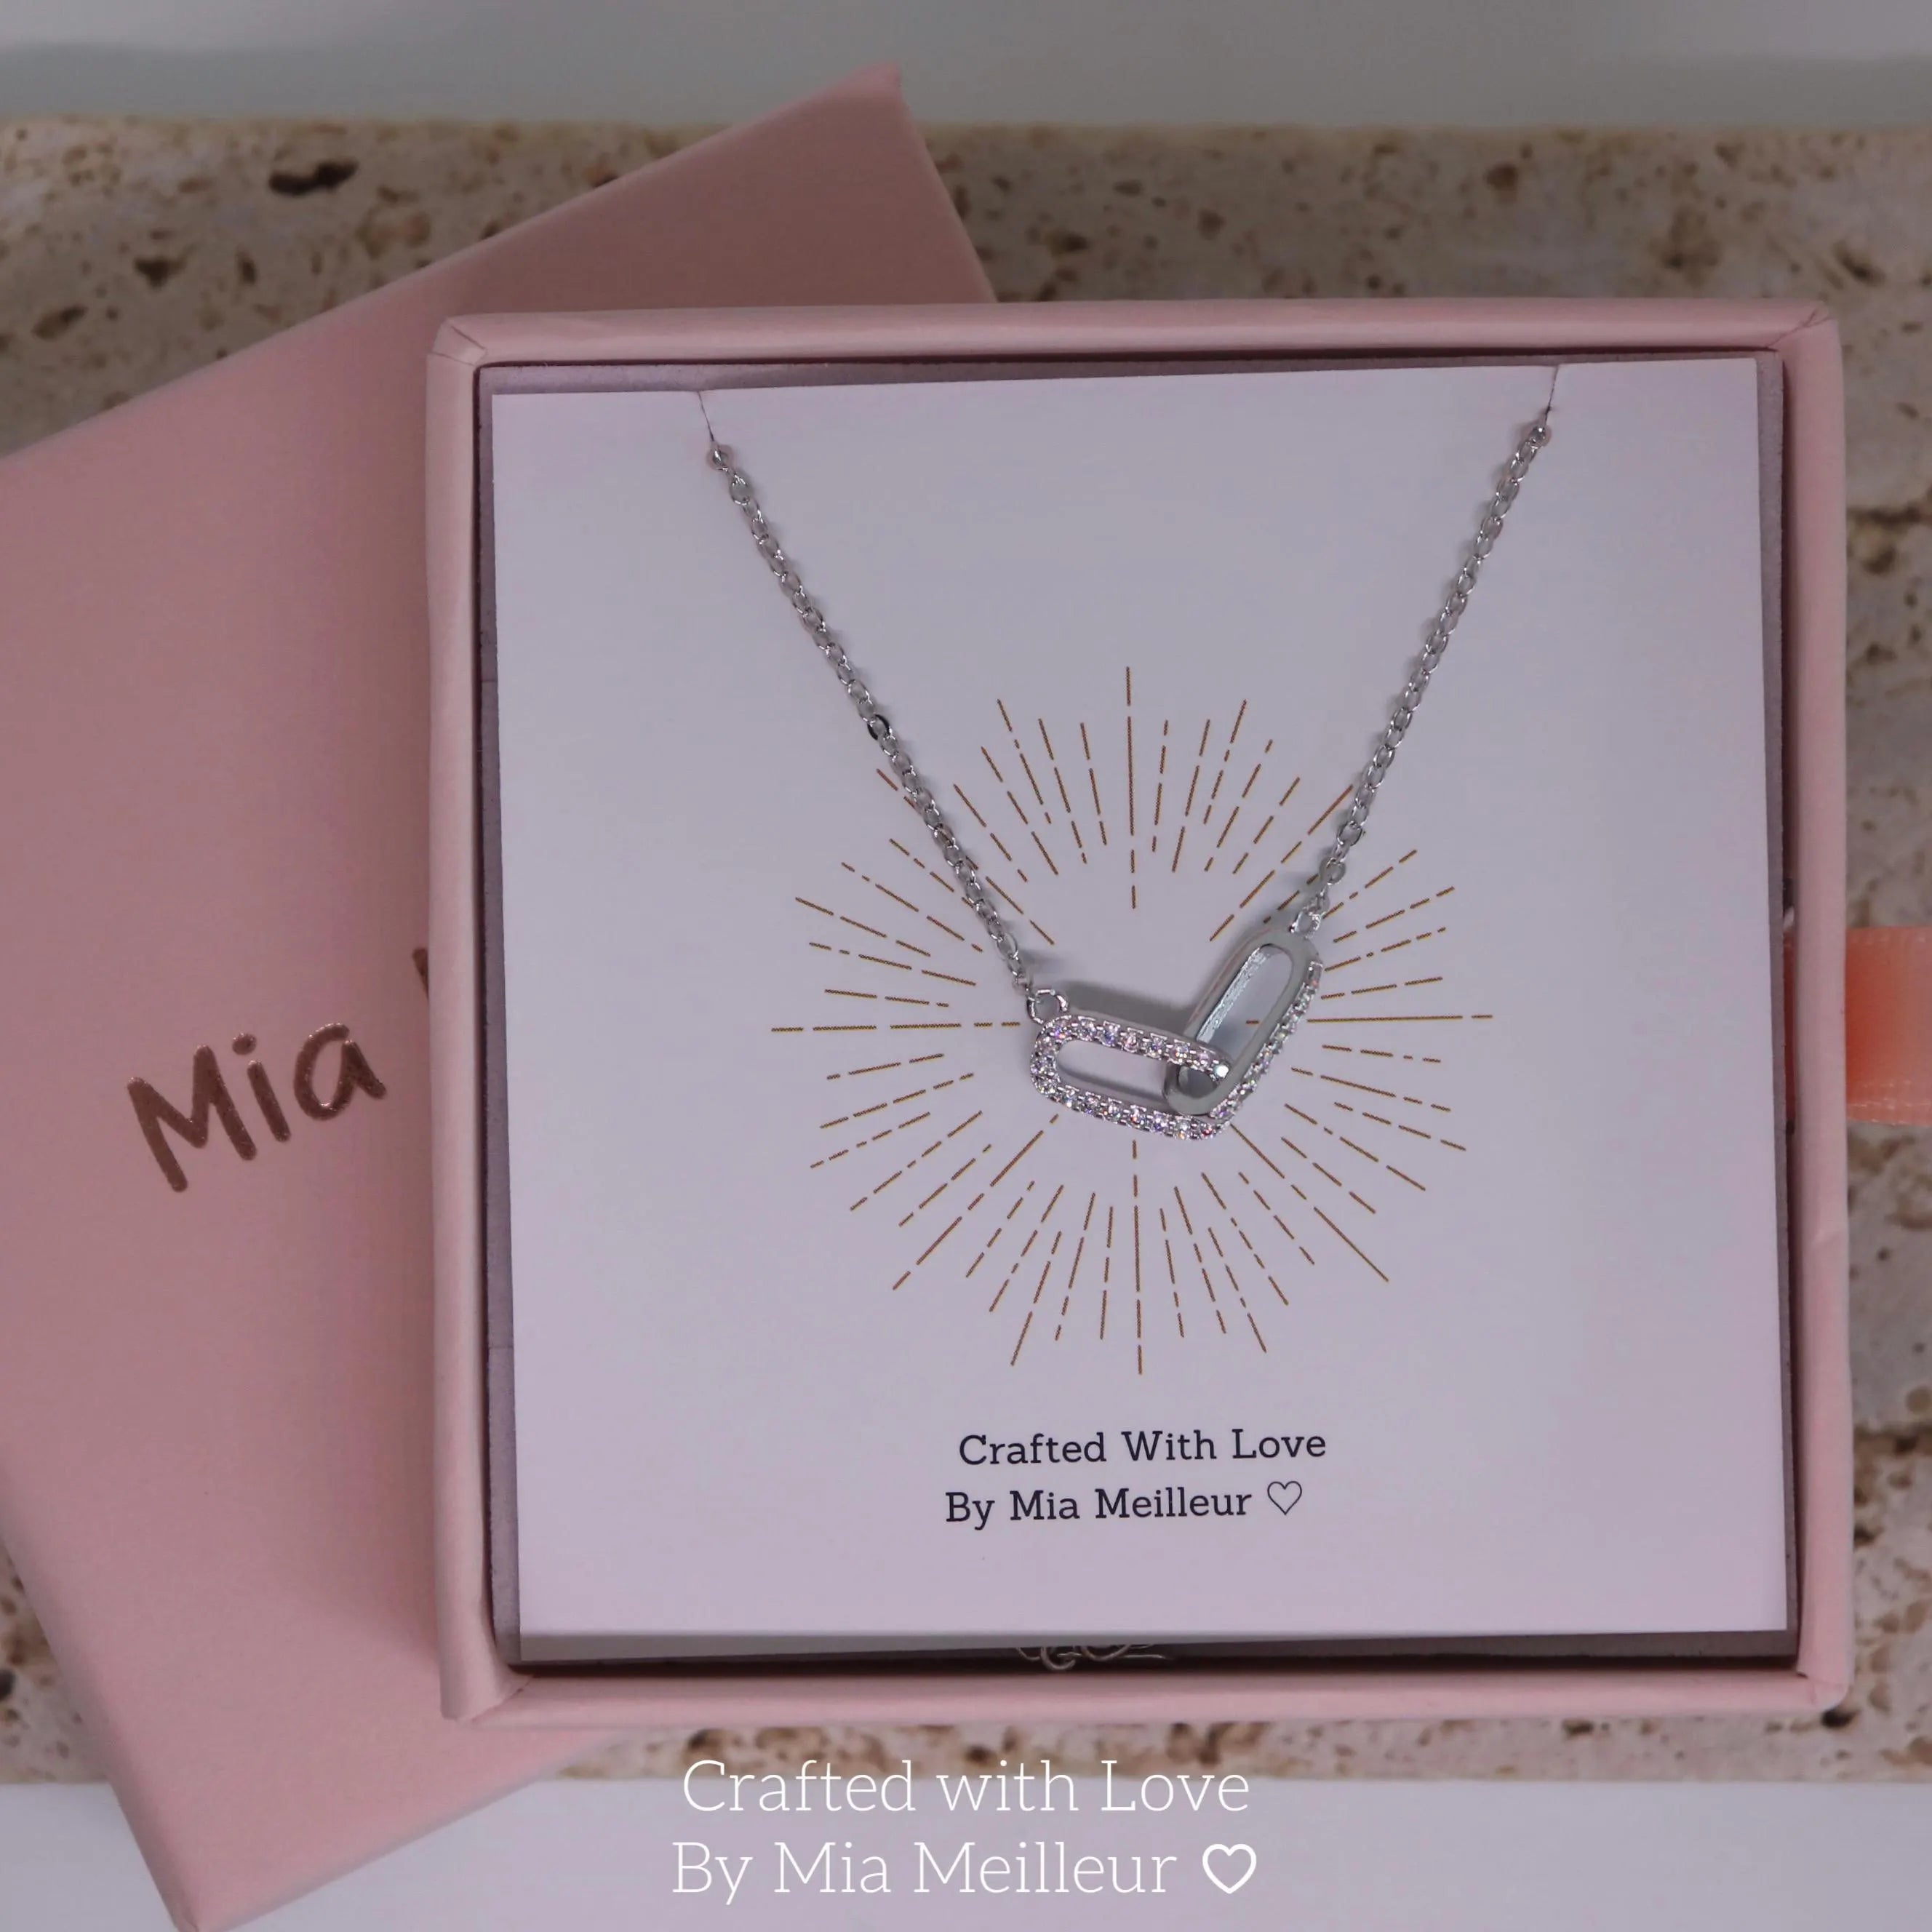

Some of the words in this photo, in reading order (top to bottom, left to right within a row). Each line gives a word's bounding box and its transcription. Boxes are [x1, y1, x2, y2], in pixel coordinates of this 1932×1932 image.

[127, 1022, 386, 1192] Mia
[959, 1432, 1107, 1466] Crafted
[1121, 1429, 1217, 1461] With
[1232, 1429, 1326, 1459] Love
[946, 1492, 995, 1530] By
[1010, 1490, 1080, 1520] Mia
[1095, 1487, 1252, 1518] Meilleur
